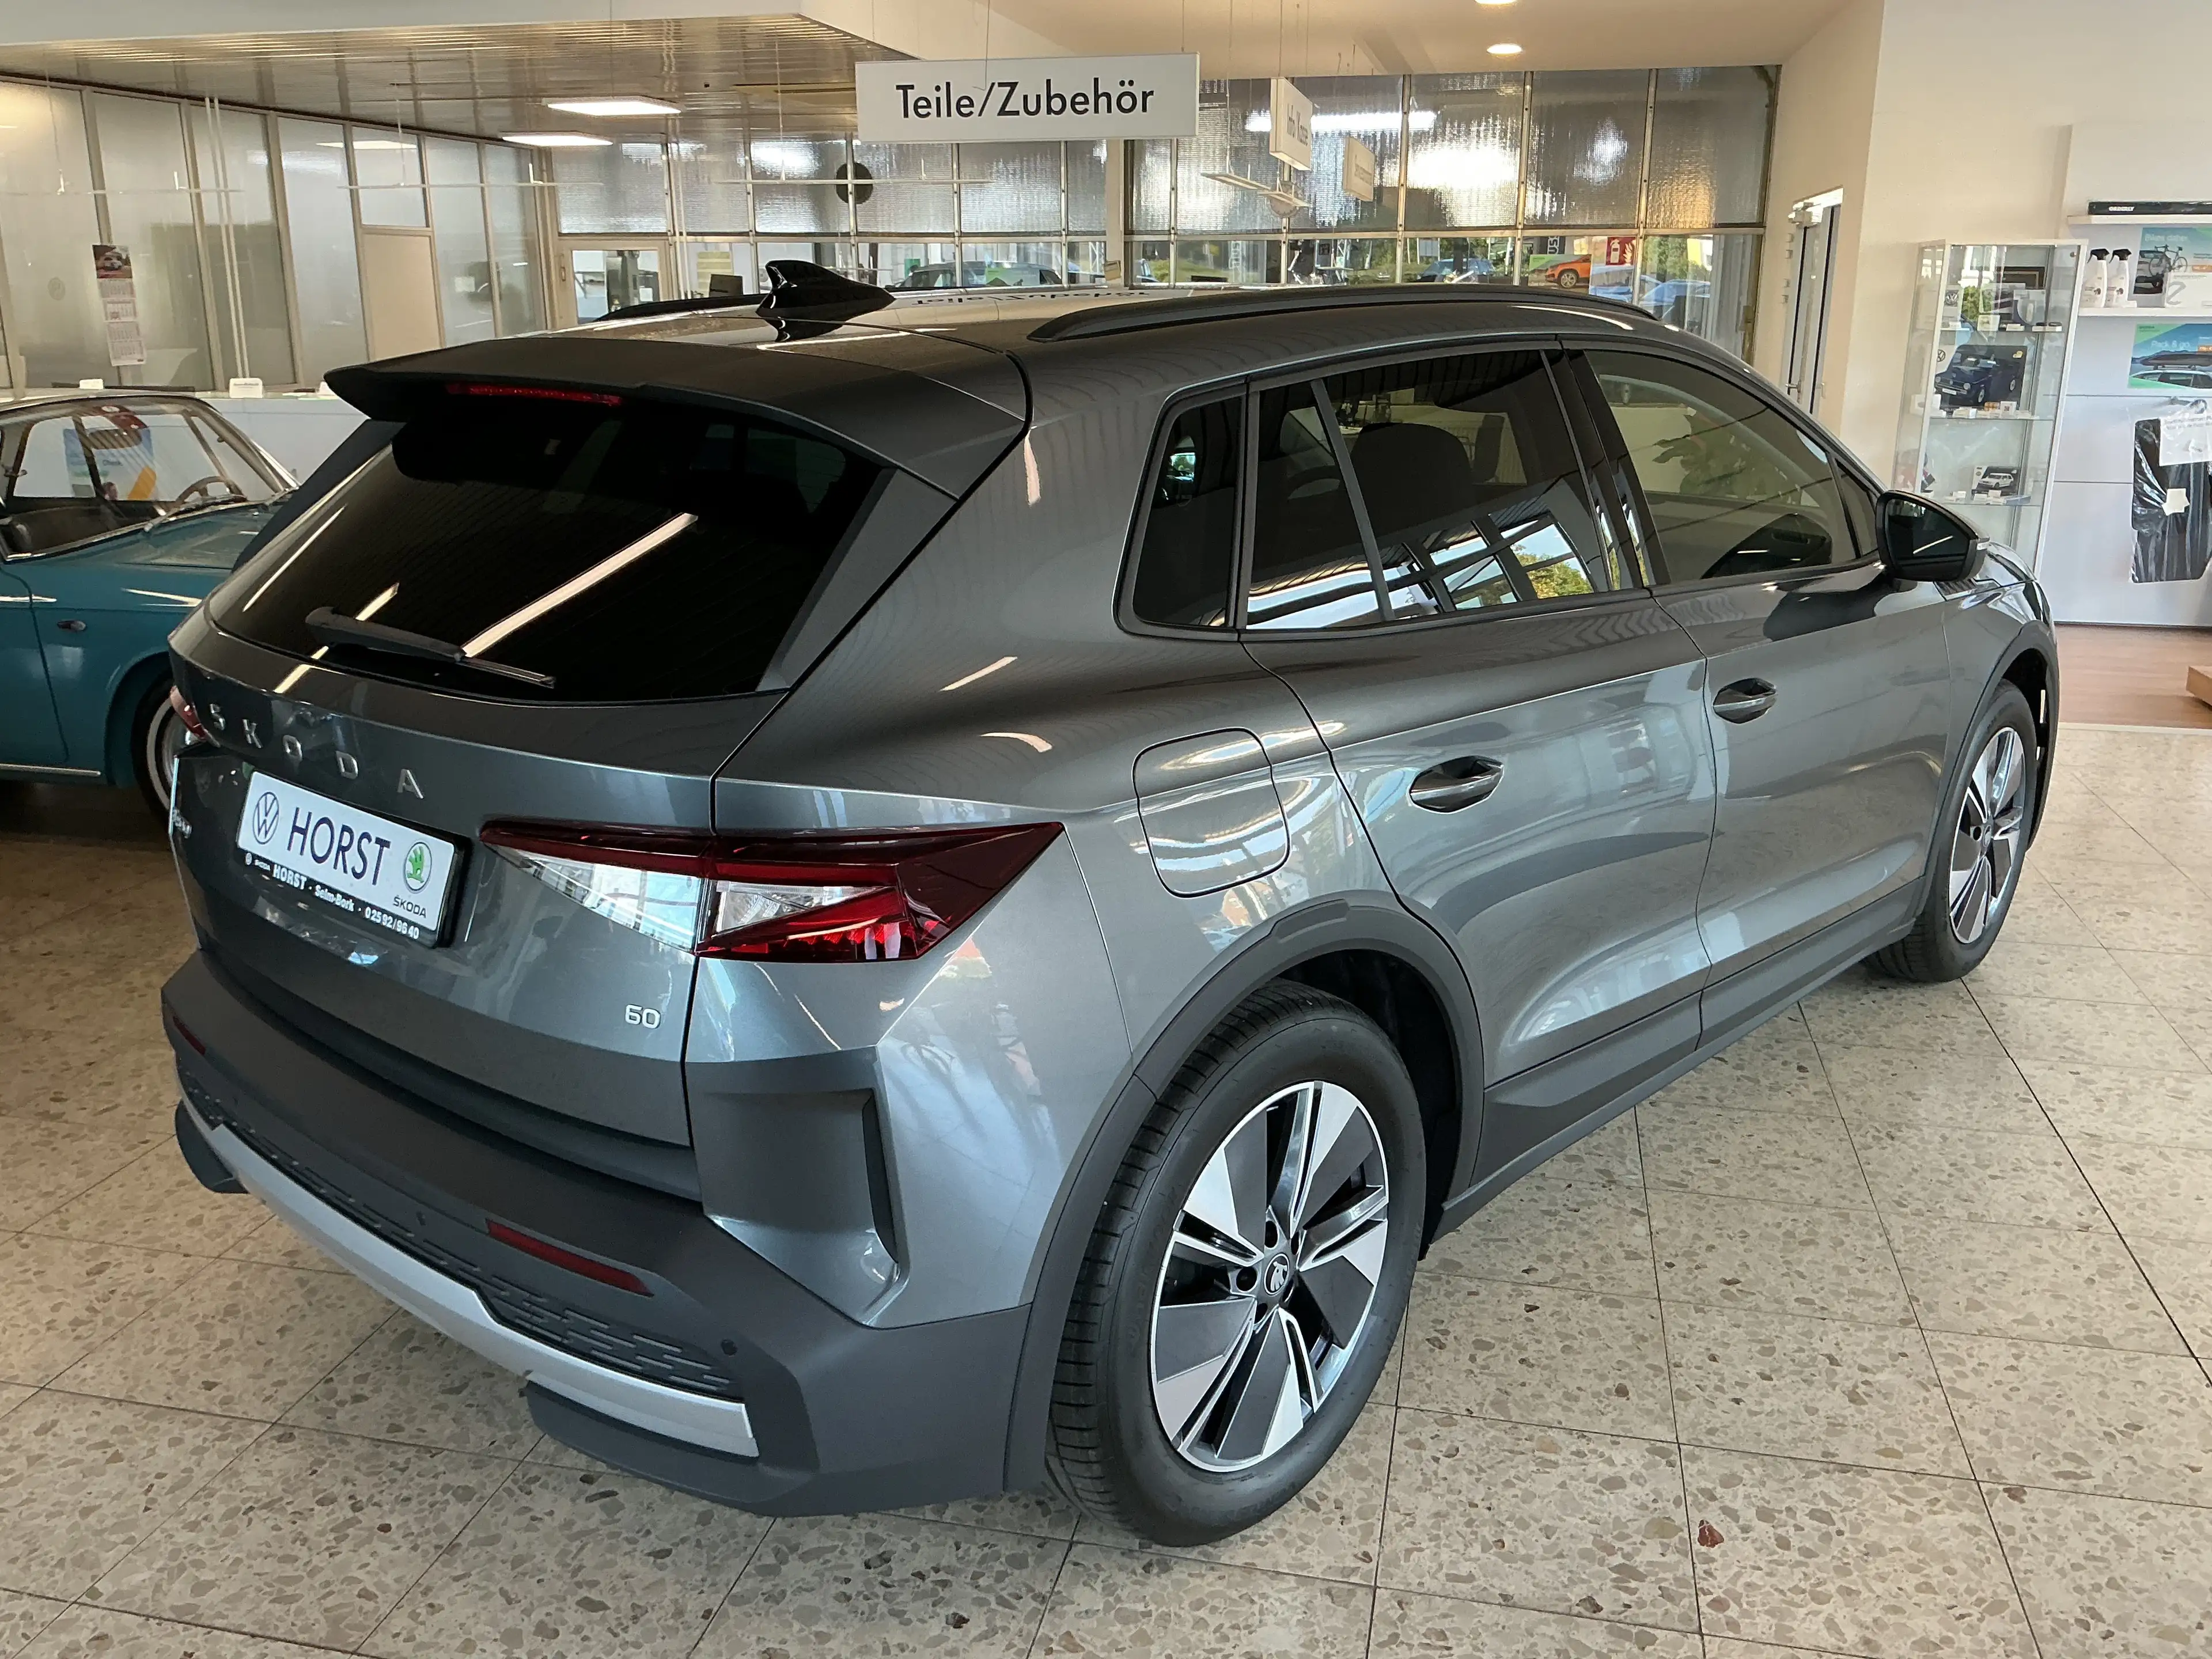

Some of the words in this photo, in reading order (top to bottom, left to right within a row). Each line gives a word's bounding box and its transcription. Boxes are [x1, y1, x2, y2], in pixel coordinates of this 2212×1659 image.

[895, 77, 1154, 119] Teile/Zubehör
[287, 806, 392, 886] HORST
[273, 863, 307, 890] HORST
[393, 894, 427, 919] ŠKODA
[625, 1003, 661, 1029] 60
